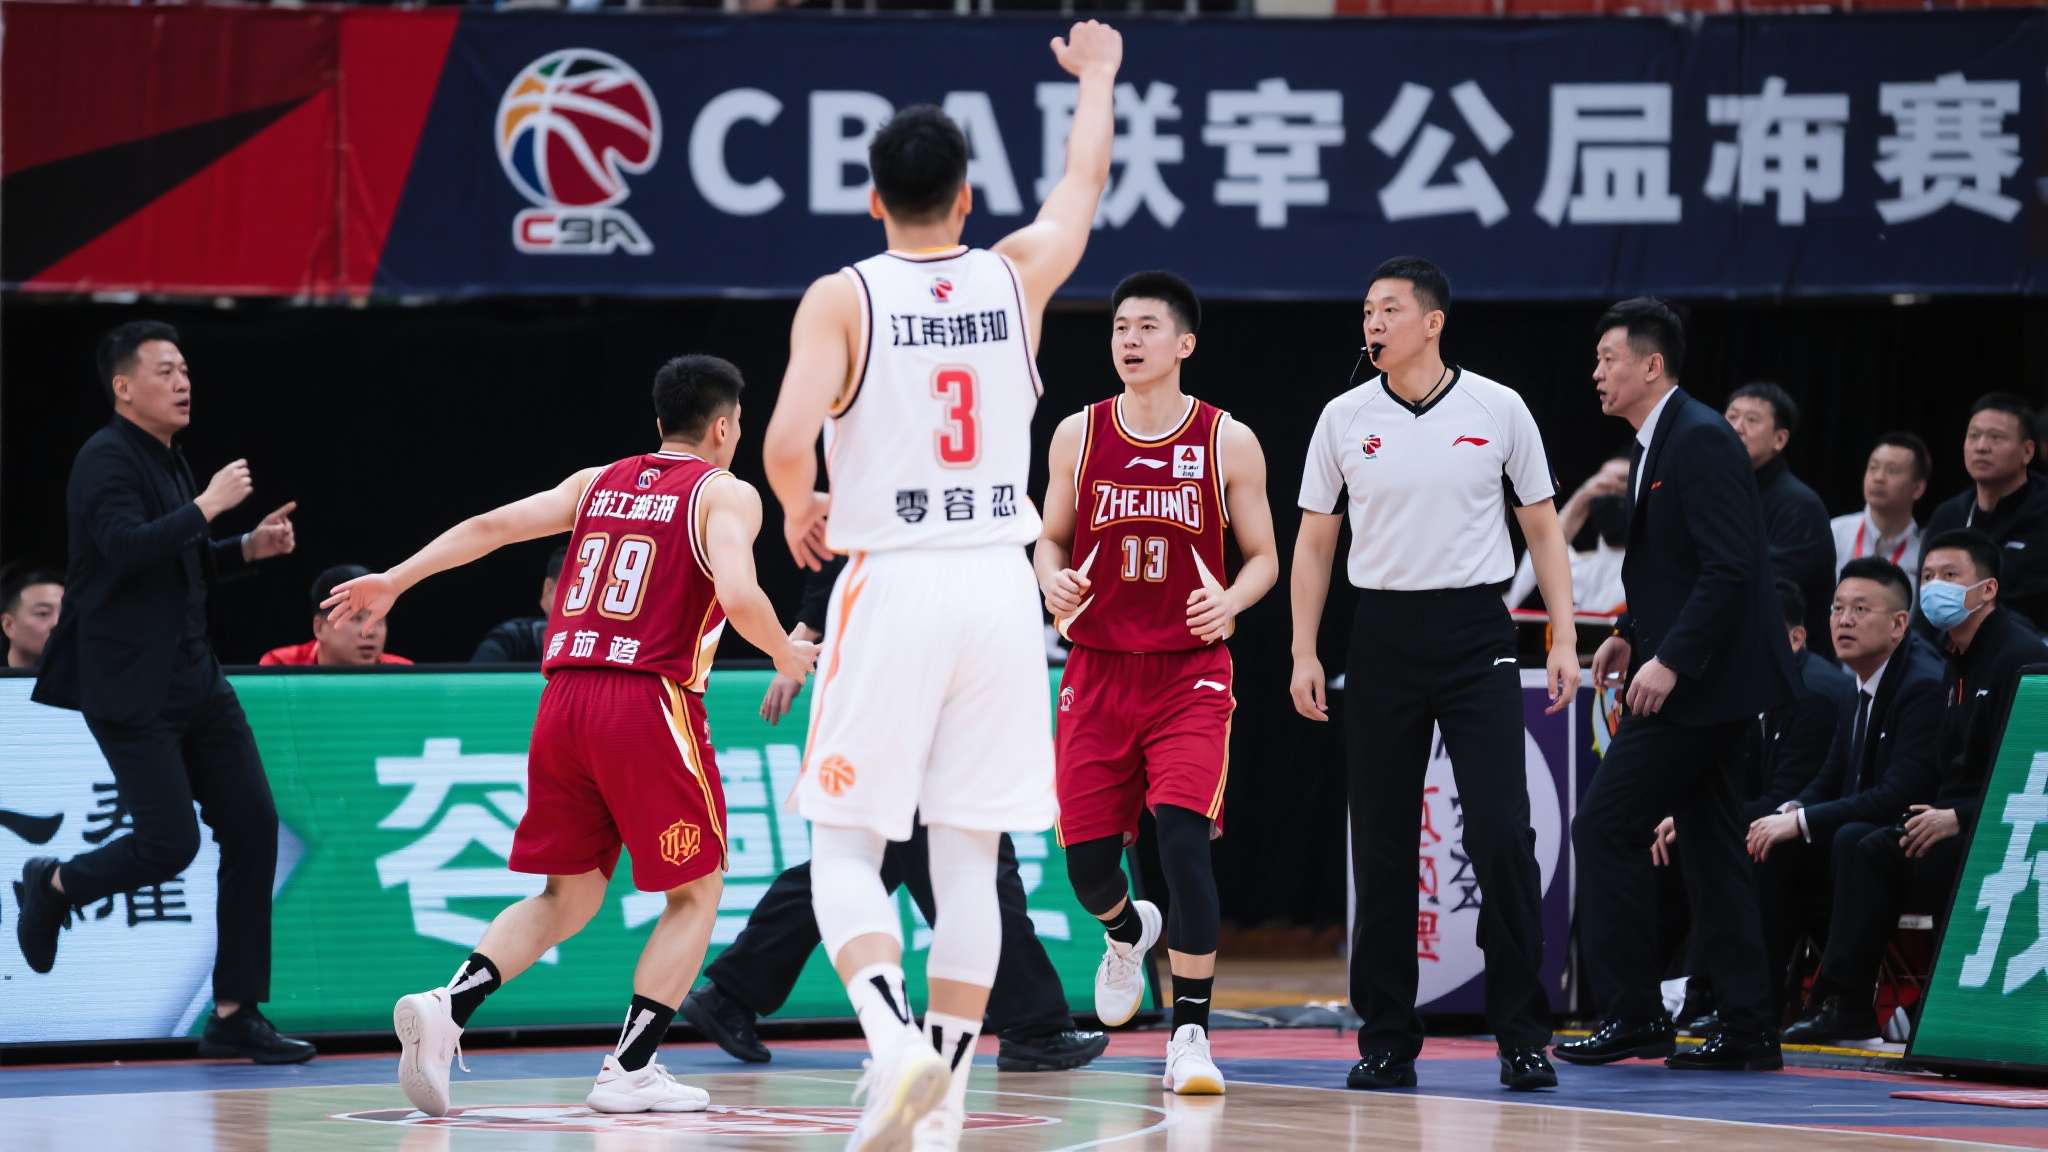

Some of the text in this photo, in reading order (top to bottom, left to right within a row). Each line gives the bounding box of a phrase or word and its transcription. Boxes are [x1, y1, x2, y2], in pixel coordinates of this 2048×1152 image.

[933, 366, 980, 467] 3
[562, 532, 656, 621] 39
[1121, 535, 1168, 582] 13
